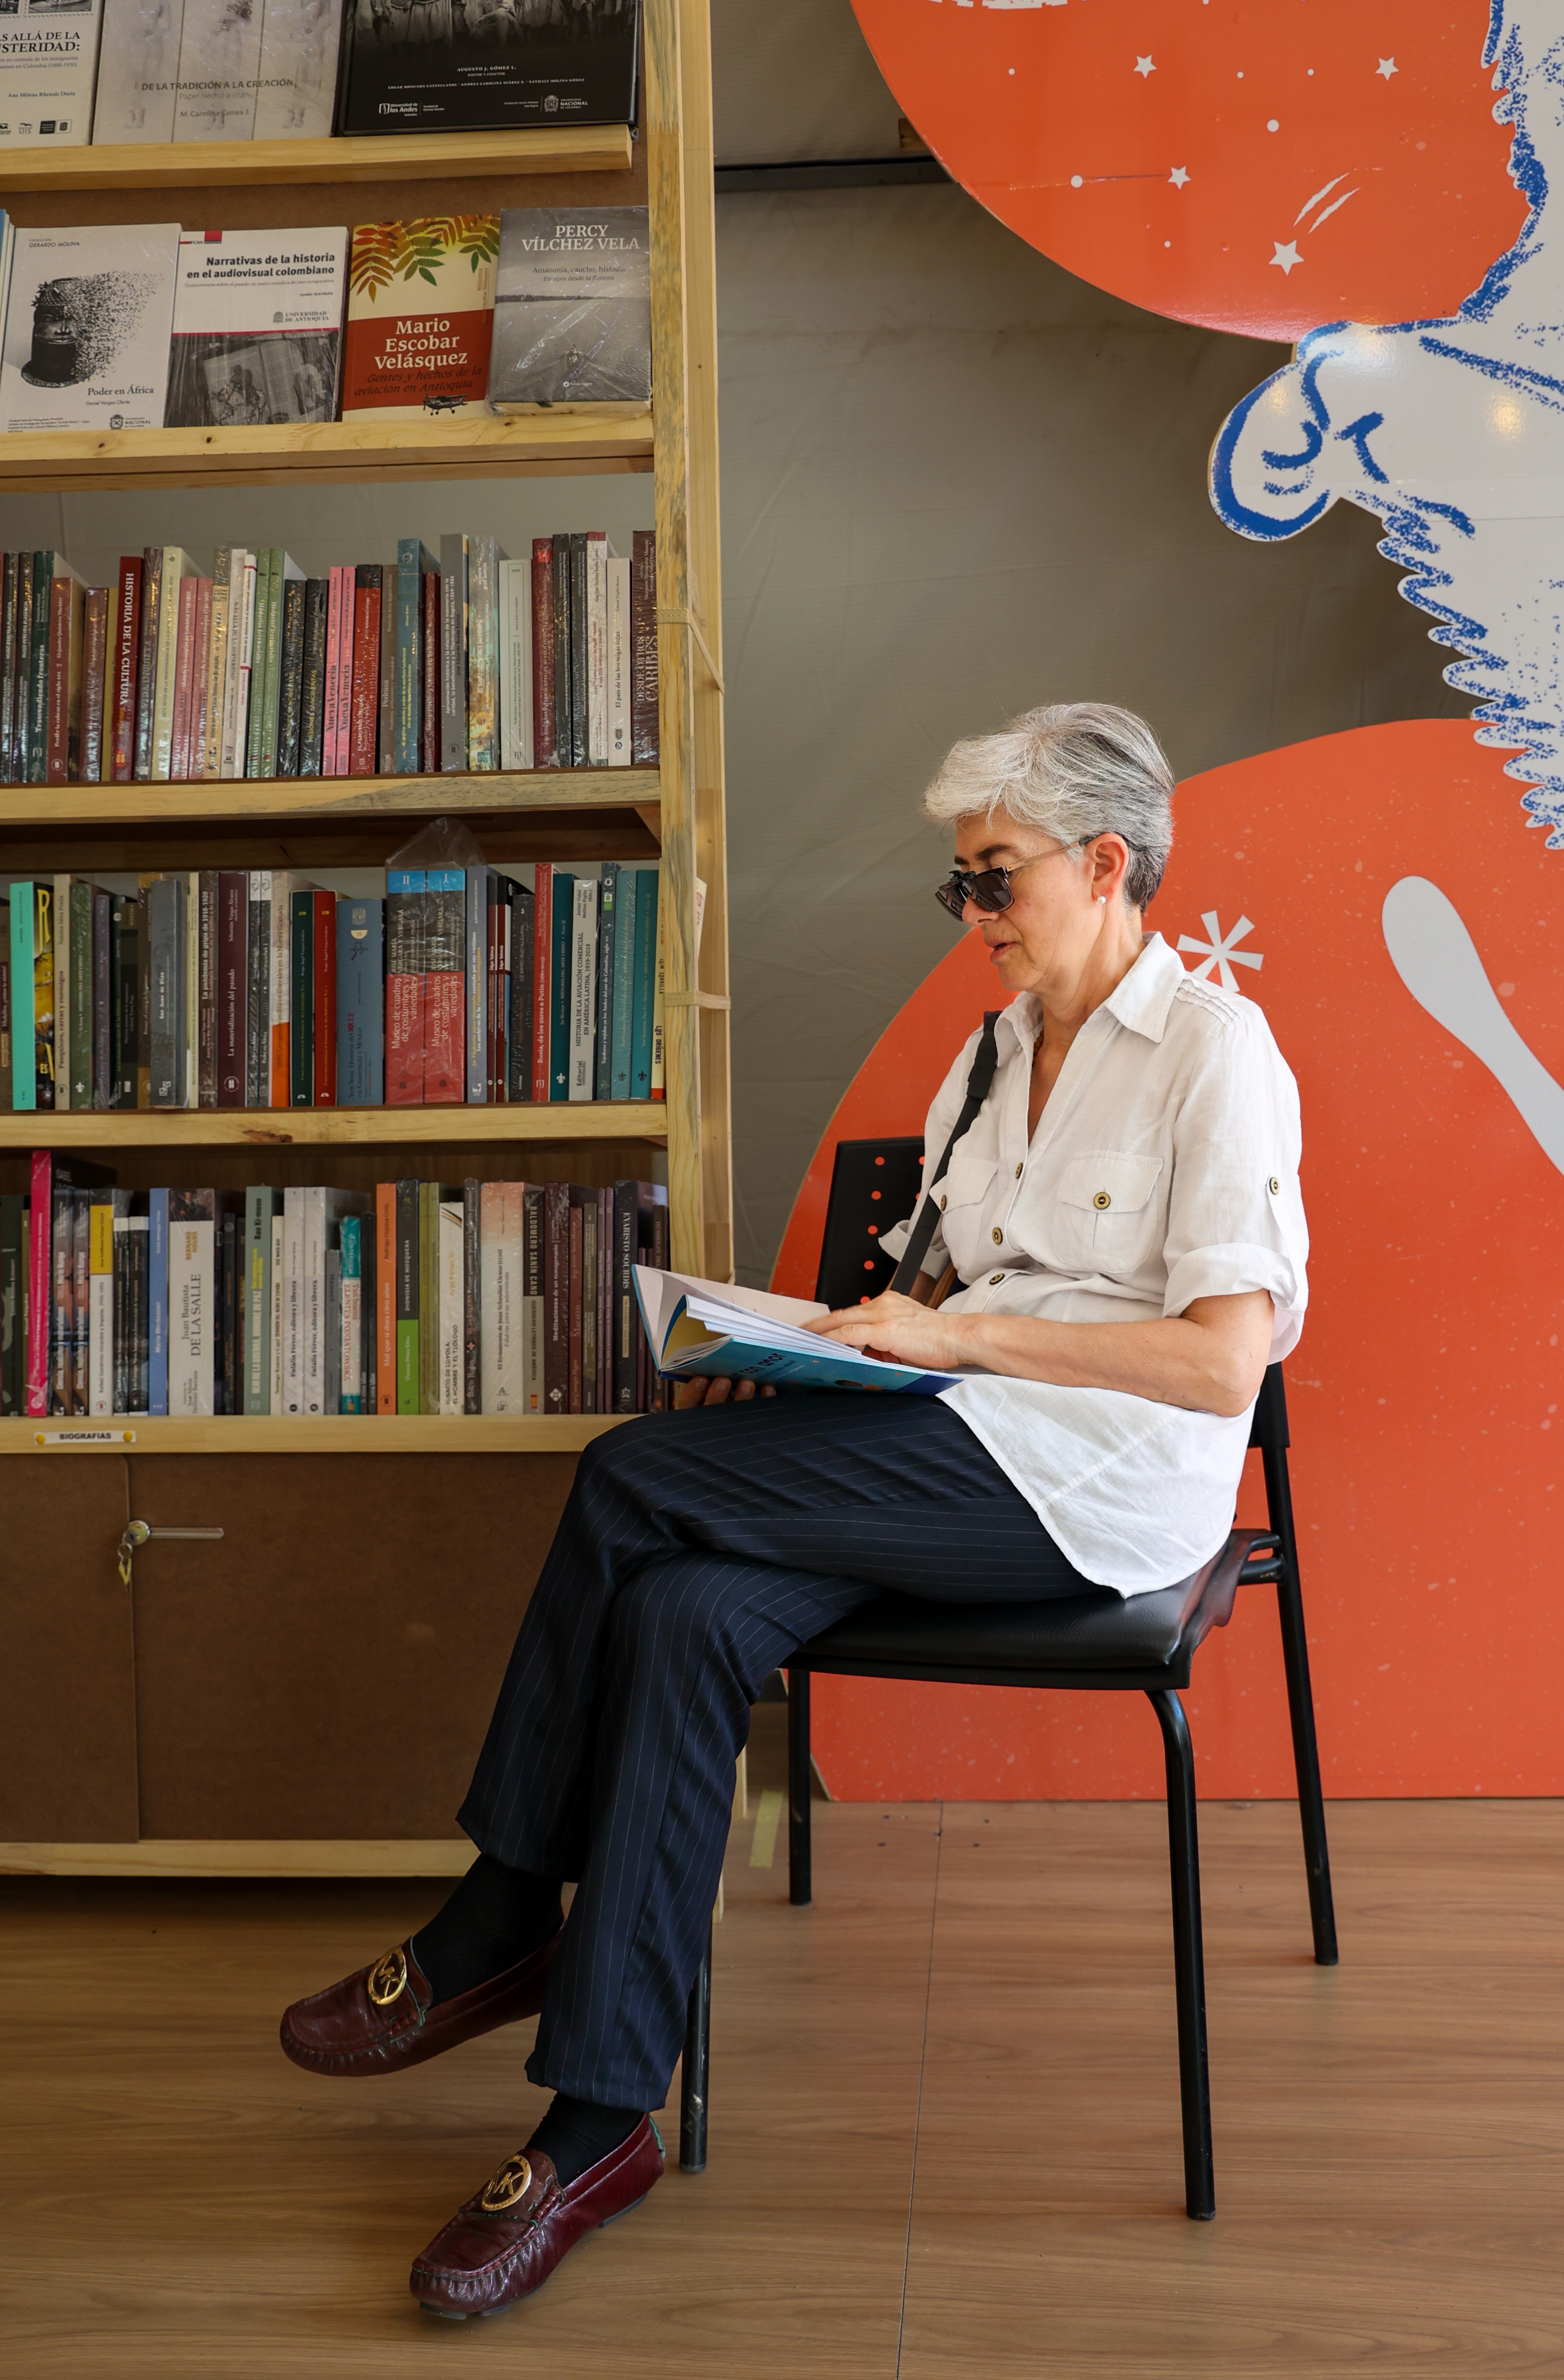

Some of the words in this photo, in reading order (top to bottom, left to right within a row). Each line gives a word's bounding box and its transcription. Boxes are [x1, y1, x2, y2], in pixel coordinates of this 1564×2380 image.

[11, 30, 43, 41] ALLÁ
[45, 32, 62, 40] DE
[65, 31, 81, 40] LA
[0, 42, 80, 53] STERIDAD:
[170, 80, 221, 90] TRADICIÓN
[555, 225, 609, 238] PERCY
[521, 236, 594, 251] VÍLCHEZ
[597, 237, 640, 250] VELA
[206, 256, 262, 266] Narrativas
[265, 255, 278, 265] de
[281, 254, 290, 264] la
[293, 252, 335, 263] historia
[187, 271, 200, 279] en
[202, 269, 212, 278] el
[214, 268, 273, 278] audiovisual
[275, 265, 335, 276] colombiano
[395, 317, 450, 335] Mario
[385, 335, 460, 352] Escobar
[374, 352, 468, 371] Velásquez
[367, 373, 404, 383] Gentes
[404, 374, 414, 383] y
[416, 369, 453, 381] hechos
[456, 367, 469, 377] de
[471, 366, 483, 375] la
[87, 387, 114, 397] Poder
[127, 384, 155, 395] África
[354, 383, 401, 396] aviación
[403, 384, 416, 392] en
[419, 379, 474, 392] Antioquia
[123, 572, 134, 622] HISTORIA
[122, 625, 131, 640] DE
[122, 642, 130, 656] LA
[635, 636, 645, 666] OTROS
[37, 644, 45, 679] fronteras
[644, 635, 658, 702] CARIBES
[119, 657, 130, 705] CULTURA
[636, 668, 645, 702] DESDE
[34, 679, 44, 733] Trascendiendo
[227, 968, 237, 990] pasado
[227, 991, 235, 1000] del
[392, 978, 402, 1009] cuadros
[410, 976, 418, 1020] variedades
[401, 984, 410, 1030] costumbres
[576, 999, 582, 1008] LA
[392, 1010, 401, 1021] de
[576, 1009, 582, 1017] DE
[227, 1001, 235, 1047] materialización
[584, 1026, 589, 1035] EN
[654, 1026, 662, 1036] LOS
[391, 1022, 401, 1049] Museo
[401, 1031, 409, 1042] de
[537, 1035, 545, 1044] de
[227, 1048, 235, 1056] La
[655, 1039, 664, 1065] ORÍGENES
[529, 1206, 538, 1249] BALDOMERO
[622, 1212, 631, 1252] EVARISTO
[529, 1251, 539, 1274] SANÍN
[404, 1274, 410, 1283] DE
[530, 1275, 538, 1295] CANO
[181, 1284, 189, 1318] Bautista
[190, 1274, 201, 1315] SALLE
[181, 1320, 190, 1340] Juan
[191, 1318, 201, 1335] LA
[190, 1338, 201, 1356] DE
[739, 1366, 766, 1374] con
[757, 1353, 787, 1367] amor
